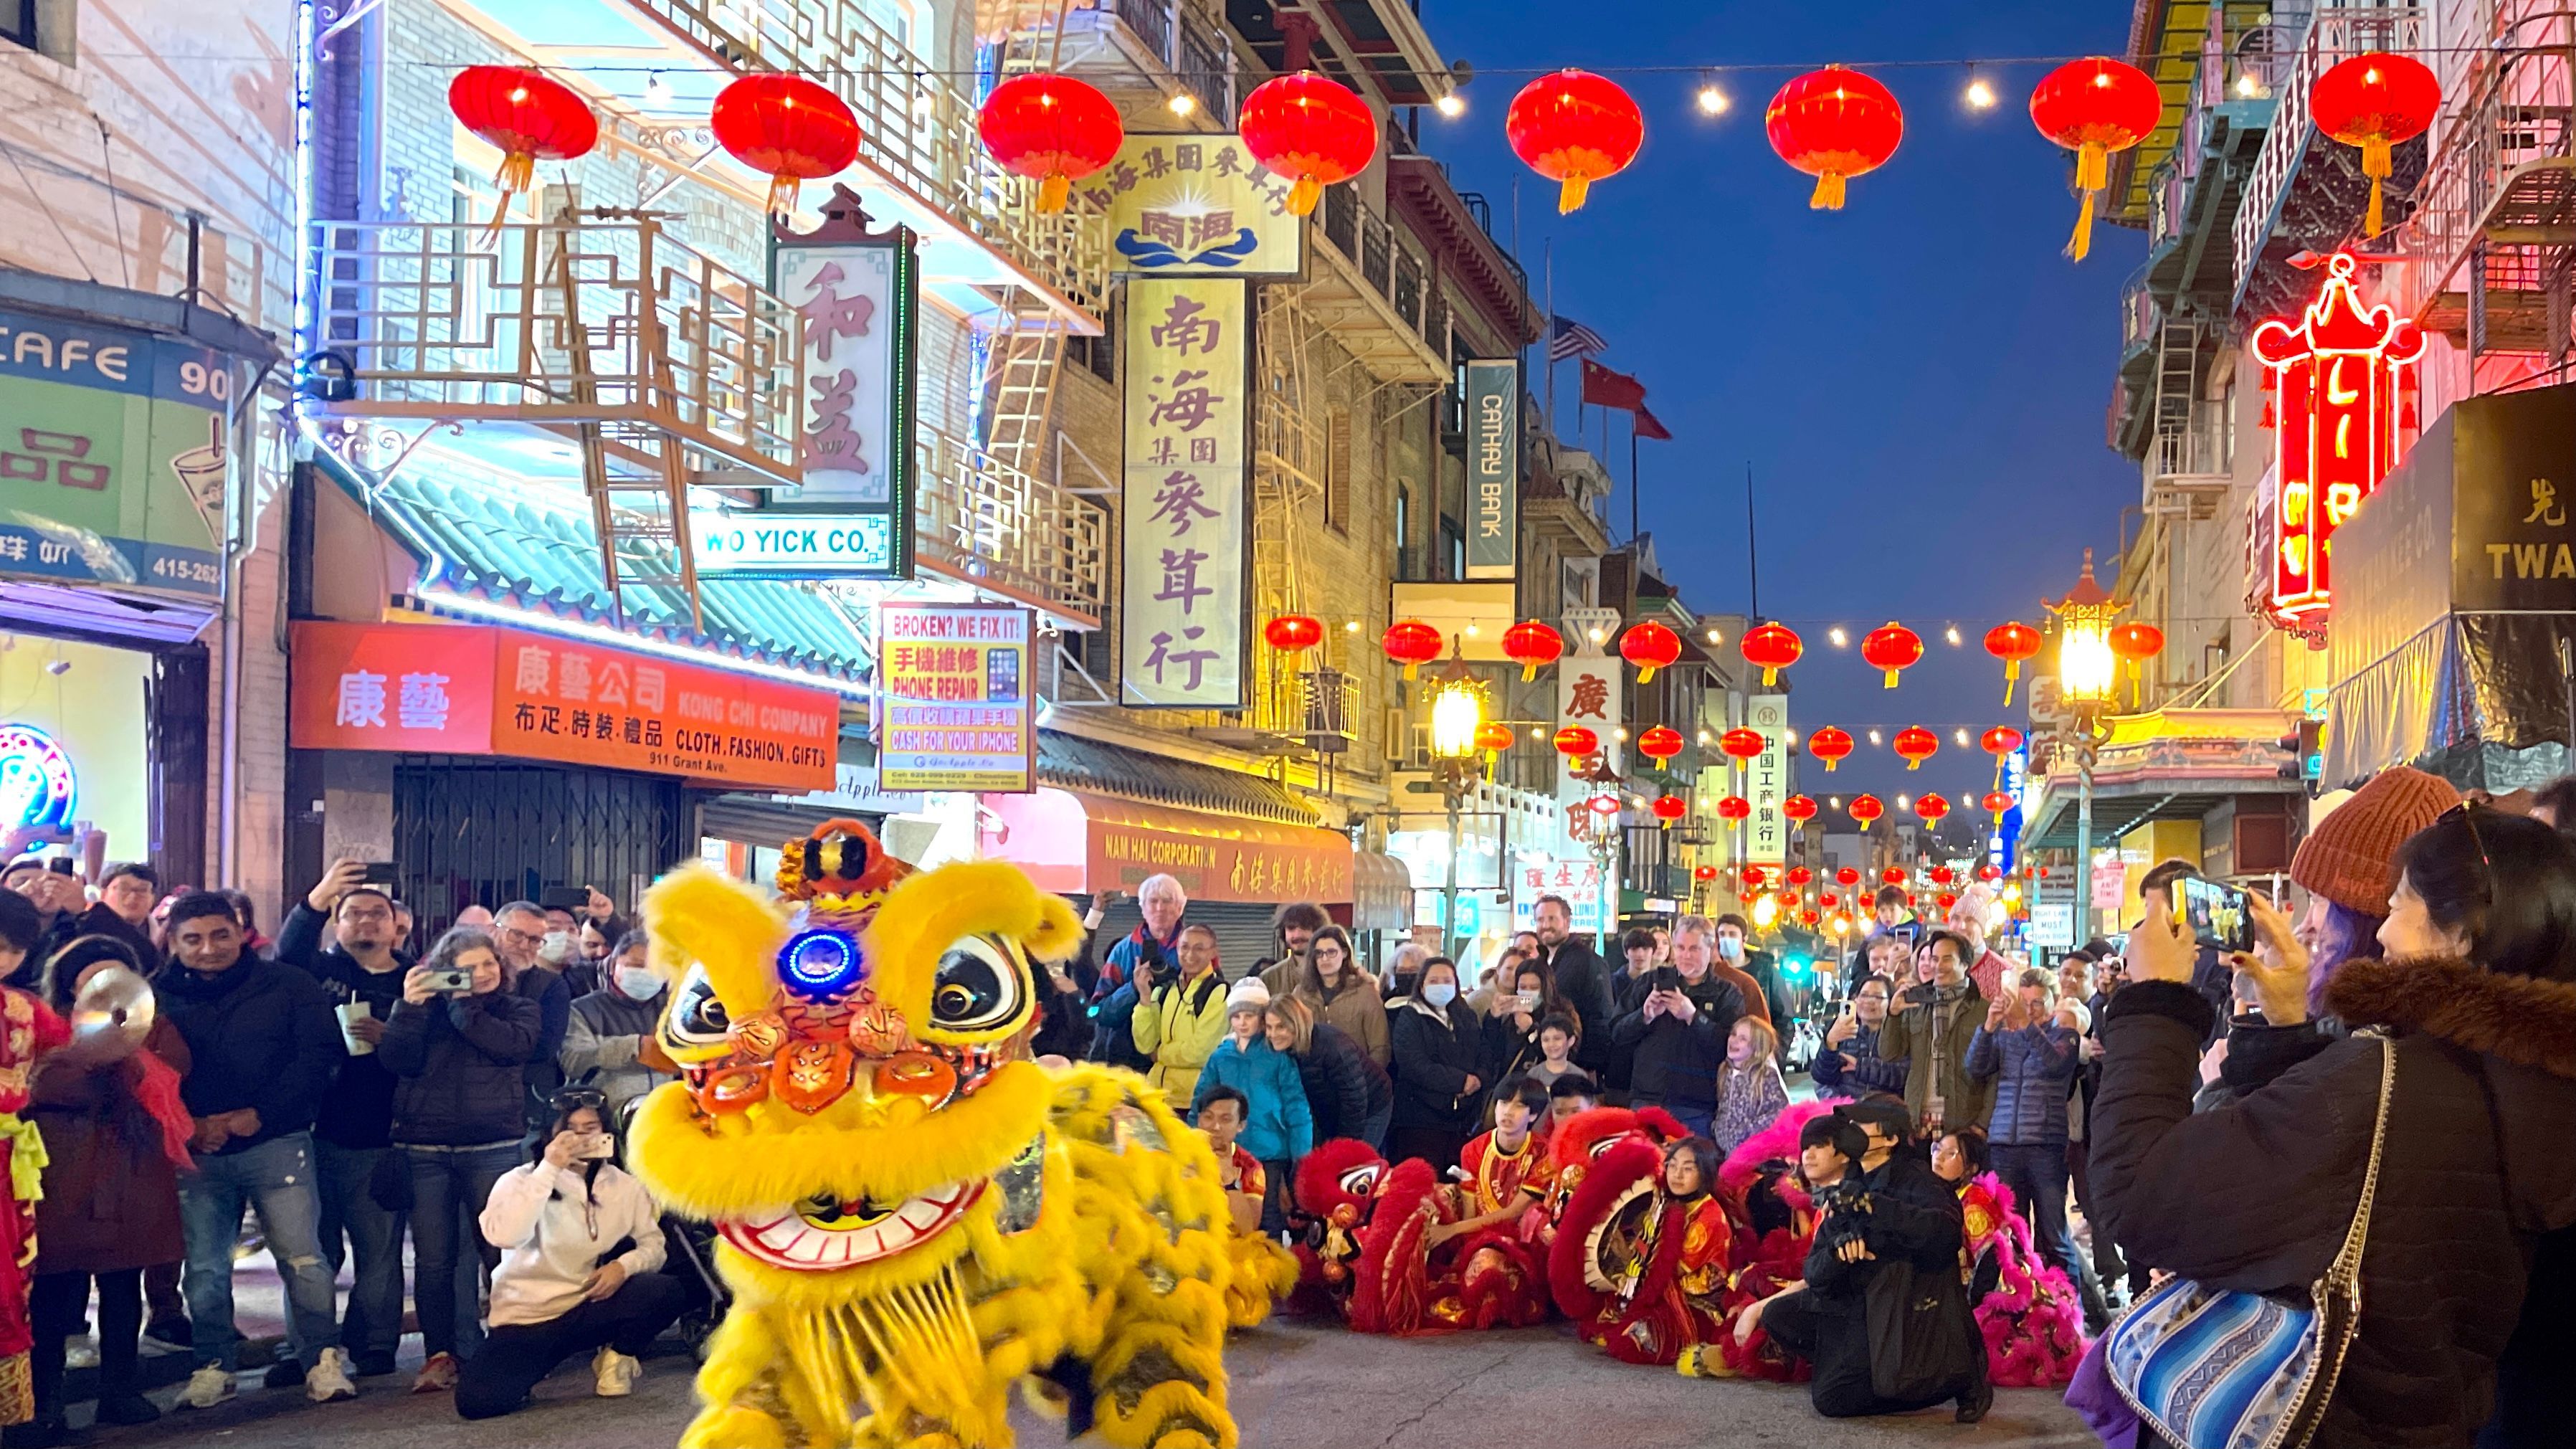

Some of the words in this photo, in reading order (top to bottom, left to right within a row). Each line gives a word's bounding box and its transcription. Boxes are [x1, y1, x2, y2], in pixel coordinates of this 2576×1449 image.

[1141, 211, 1233, 250] 南海
[0, 327, 128, 381] AFE
[797, 261, 875, 475] 和益
[1481, 394, 1502, 475] CATHAY
[1481, 483, 1501, 538] BANK
[705, 531, 744, 552] WO
[756, 531, 817, 552] YICK
[828, 531, 869, 553] CO.
[893, 615, 952, 637] BROKEN?
[957, 617, 976, 637] WE
[980, 617, 999, 638] FIX
[1004, 617, 1020, 638] IT!
[893, 647, 978, 673] 手機維修
[515, 644, 666, 714] 康藝公司
[893, 677, 932, 700] PHONE
[937, 678, 978, 700] REPAIR
[336, 669, 451, 731] 康藝
[678, 691, 723, 723] KONG
[729, 700, 755, 727] CHI
[760, 706, 827, 738] COMPANY
[891, 731, 921, 751] CASH
[923, 731, 944, 751] FOR
[947, 731, 976, 751] YOUR
[979, 732, 1017, 752] IPHONE
[650, 751, 669, 766] 911
[672, 755, 702, 770] Grant
[705, 759, 728, 773] Ave.
[1105, 834, 1128, 860] NAM
[1131, 837, 1149, 862] HAI
[1151, 840, 1216, 869] CORPORATION
[2041, 921, 2063, 929] MUST
